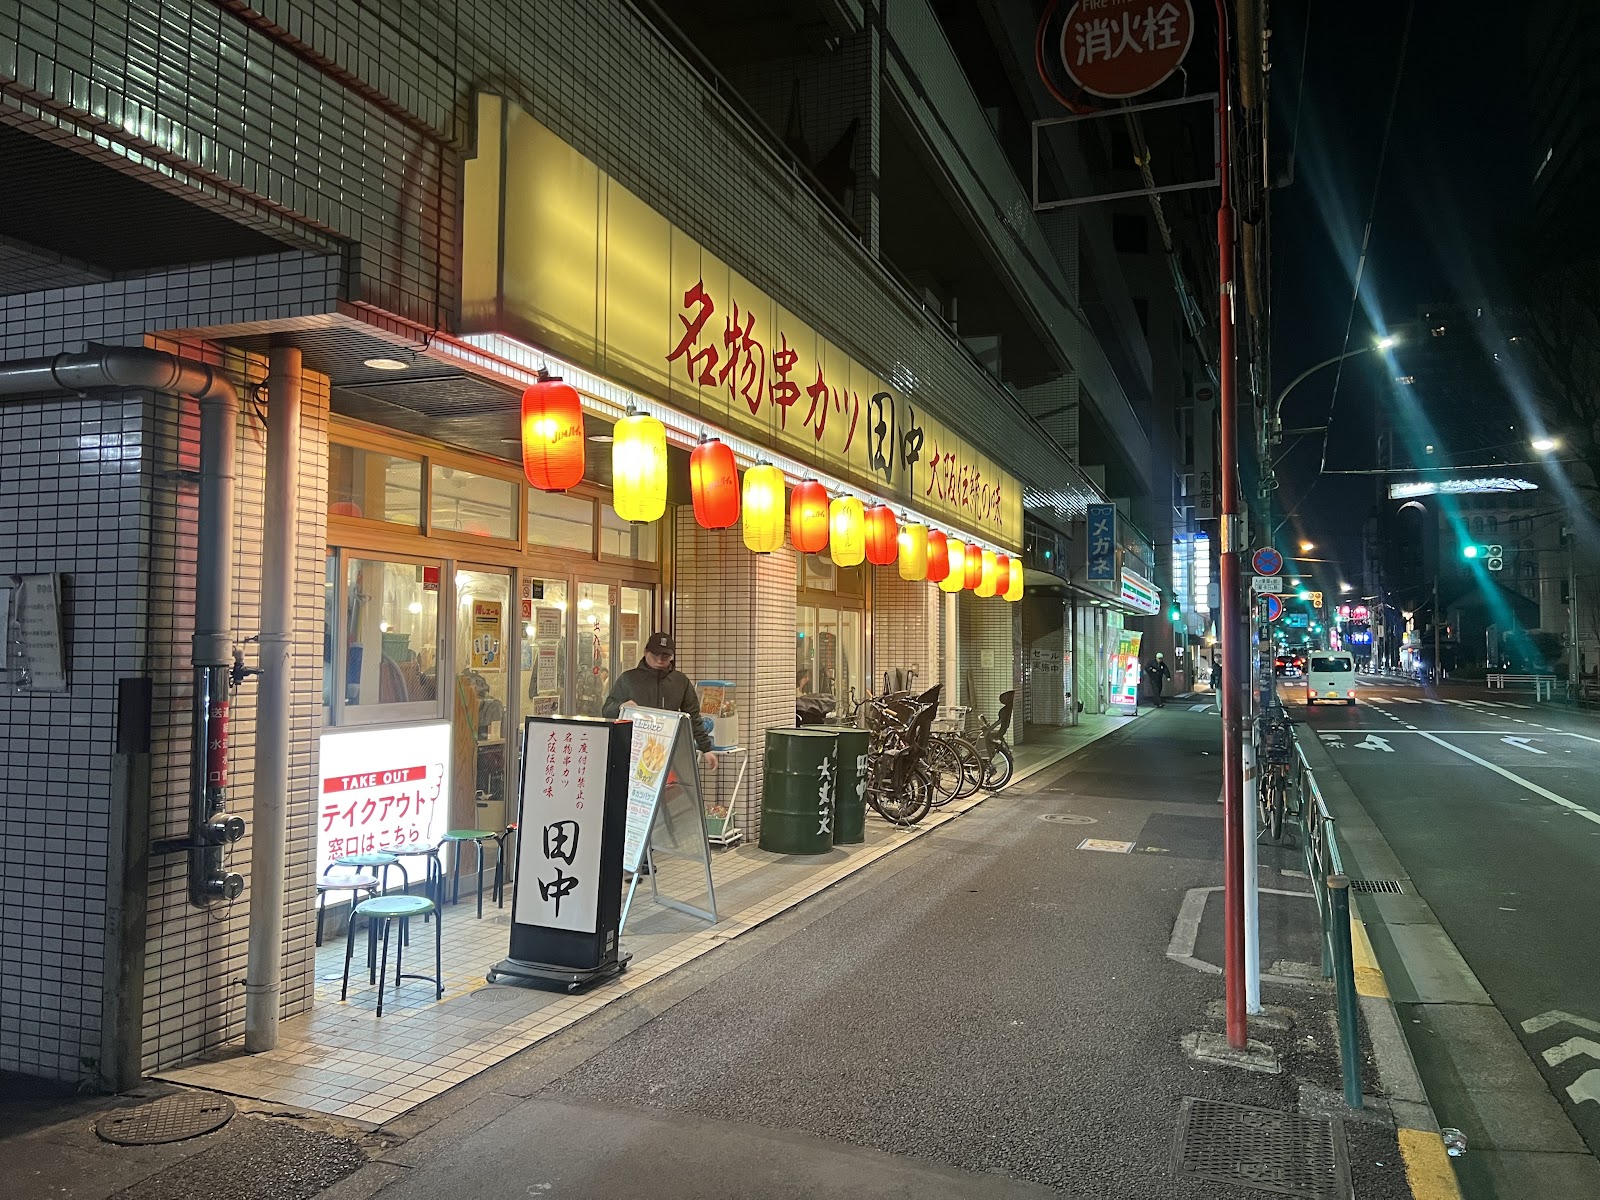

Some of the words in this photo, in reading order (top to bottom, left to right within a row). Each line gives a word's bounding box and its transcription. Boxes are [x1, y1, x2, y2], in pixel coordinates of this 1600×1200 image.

[1075, 2, 1181, 66] 消火栓
[926, 438, 1003, 527] 大阪伝統の味
[1200, 470, 1212, 508] 太陽生命
[1092, 518, 1111, 575] メガネ
[1032, 649, 1060, 660] セール
[209, 707, 223, 782] 送水口
[542, 731, 557, 798] 大阪伝統の味
[561, 732, 573, 788] 名物串カツ
[575, 732, 589, 810] 二度付け禁止の
[341, 774, 377, 791] TAKE
[382, 769, 410, 784] OUT
[855, 753, 869, 802] 田中
[322, 790, 426, 832] テイクアウト
[327, 823, 420, 861] 窓口はこちら
[537, 819, 580, 918] 田中
